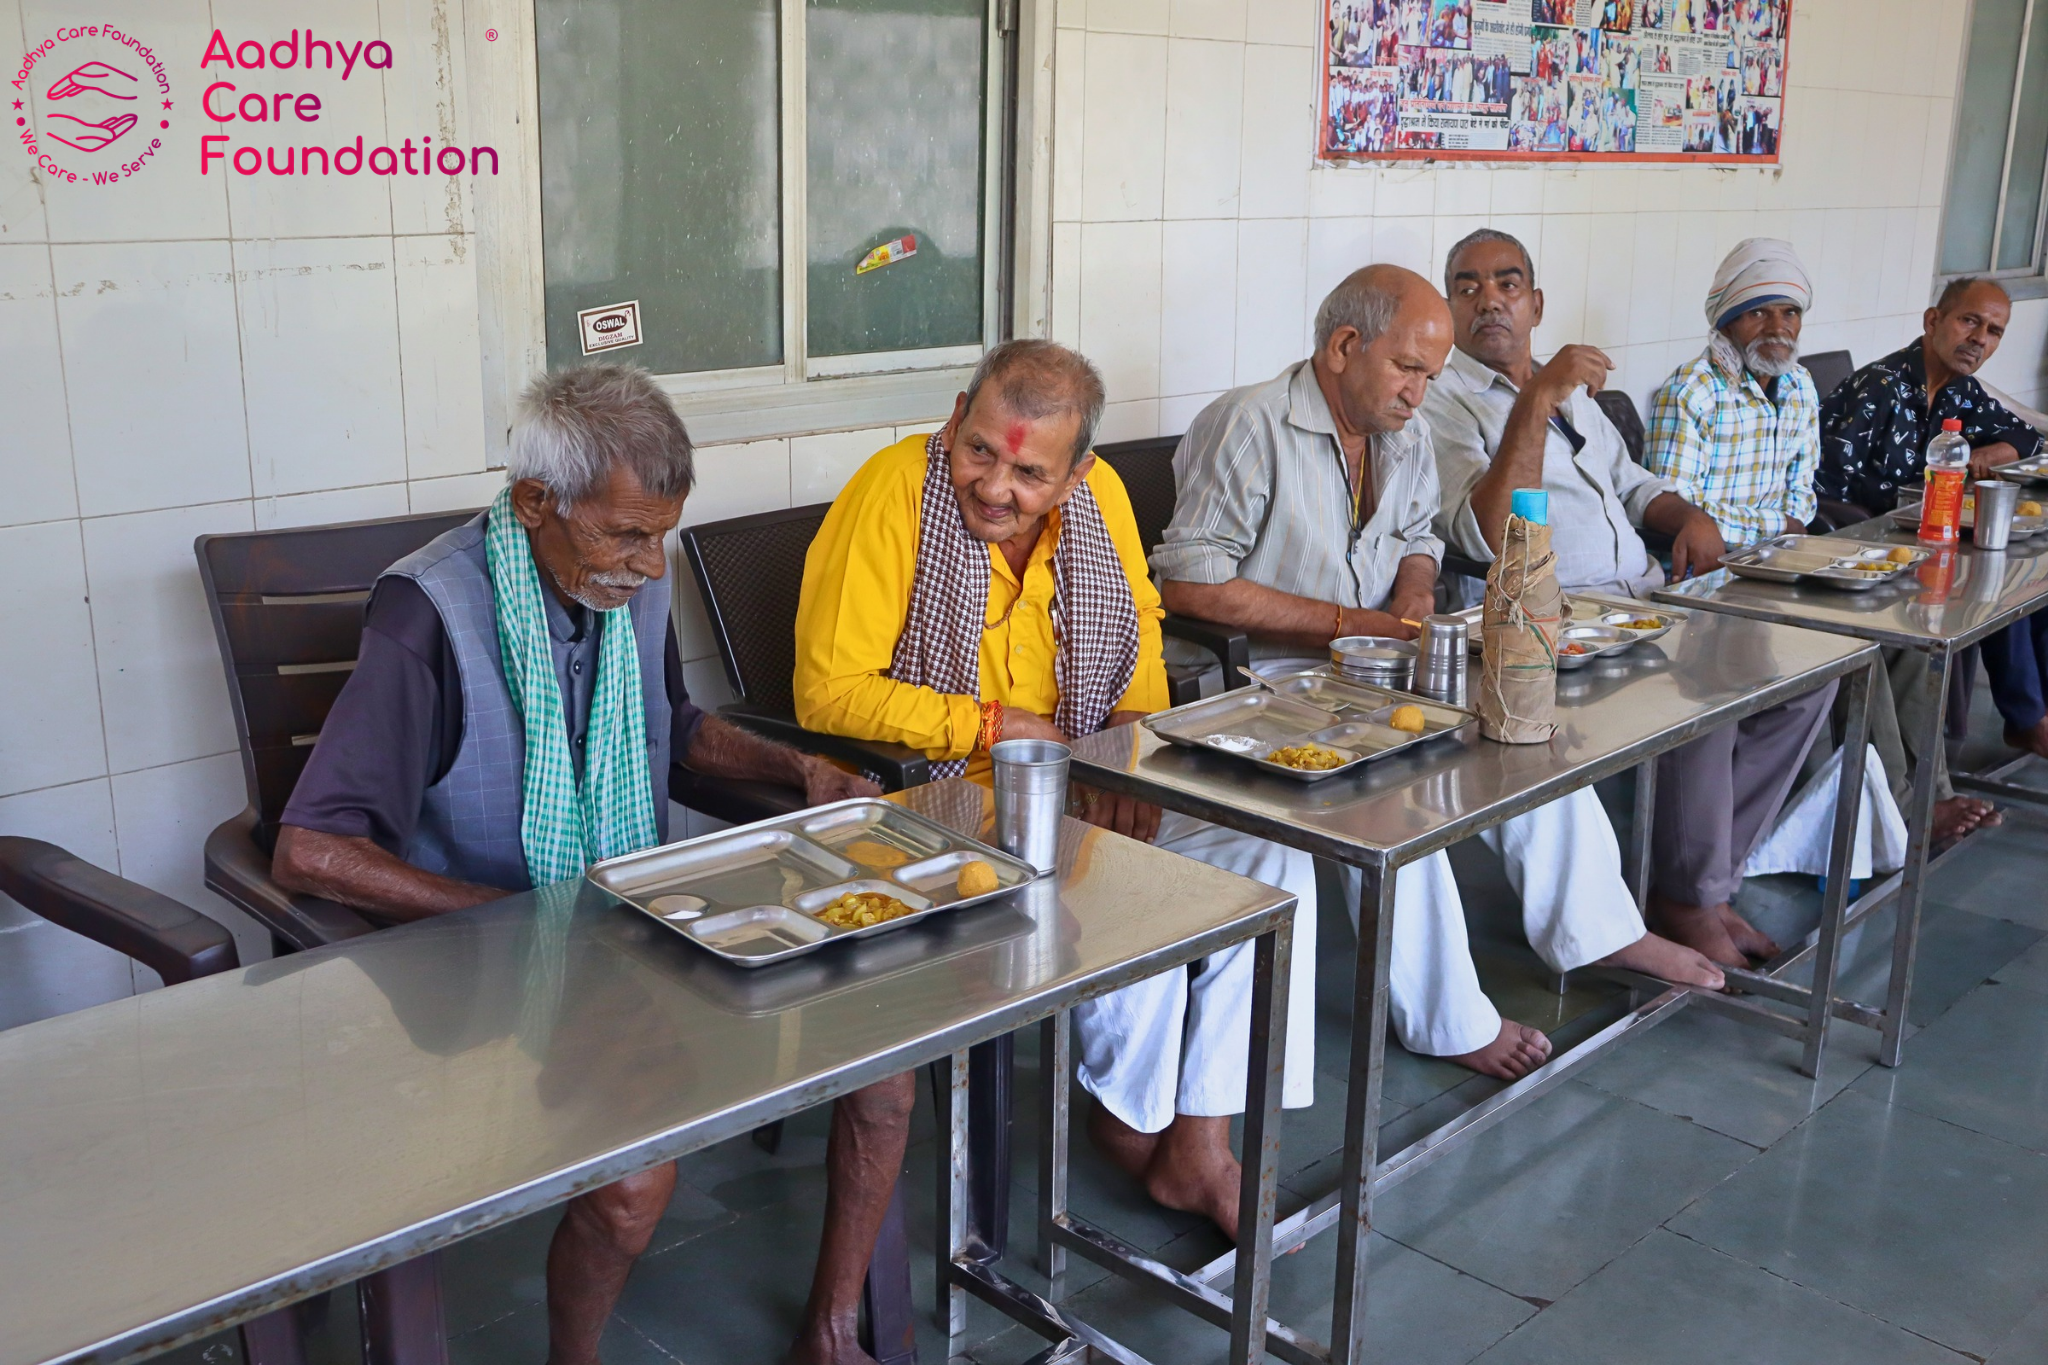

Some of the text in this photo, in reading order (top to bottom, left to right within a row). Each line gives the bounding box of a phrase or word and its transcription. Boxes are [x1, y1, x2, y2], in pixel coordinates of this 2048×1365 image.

[596, 317, 625, 331] OSWAL
[589, 335, 634, 348] EXCLUSIVE QUALITY
